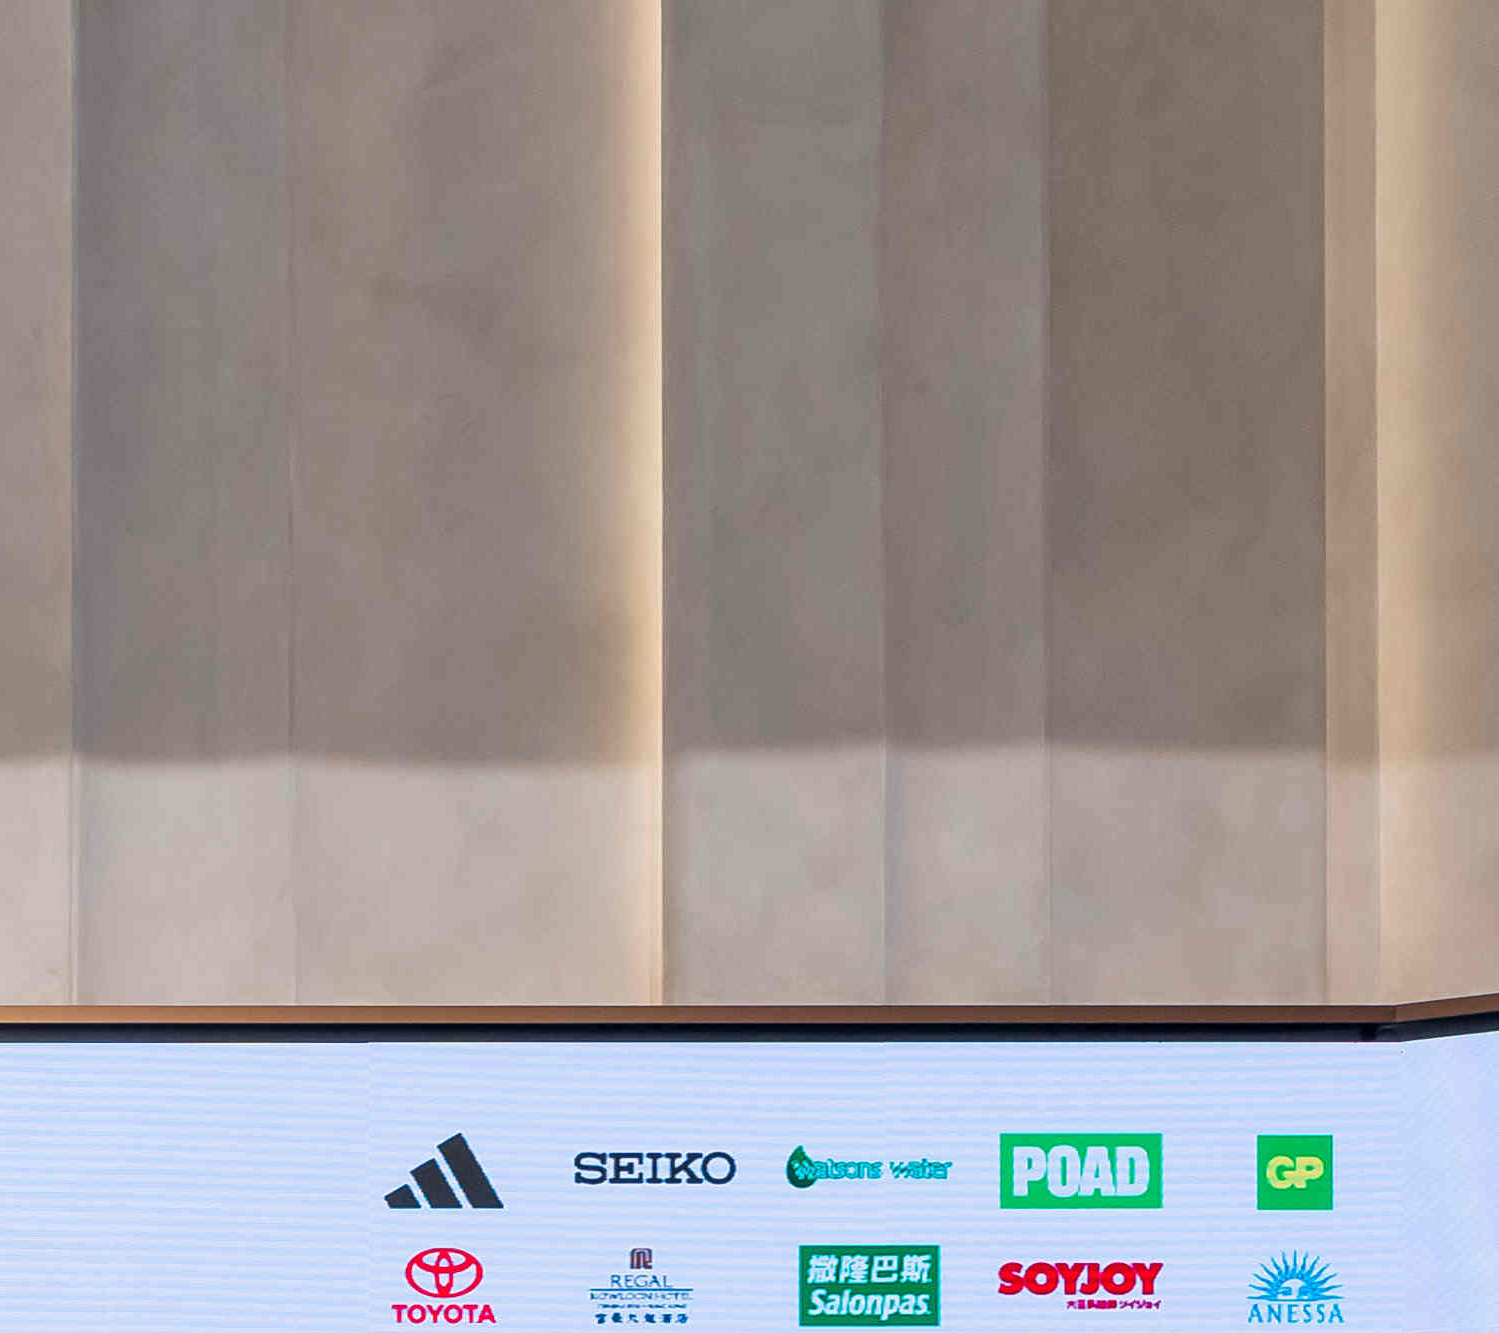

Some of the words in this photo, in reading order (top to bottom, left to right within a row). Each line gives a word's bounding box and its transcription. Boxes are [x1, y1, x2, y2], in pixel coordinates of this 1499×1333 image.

[574, 1152, 737, 1185] SEIKO
[1012, 1145, 1151, 1198] POAD
[1265, 1155, 1324, 1190] GP
[610, 1274, 674, 1288] REGAL
[998, 1261, 1164, 1296] SOYJOY
[391, 1304, 497, 1325] TOYOTA
[808, 1289, 931, 1321] Salonpas
[1247, 1303, 1345, 1324] ANESSA
